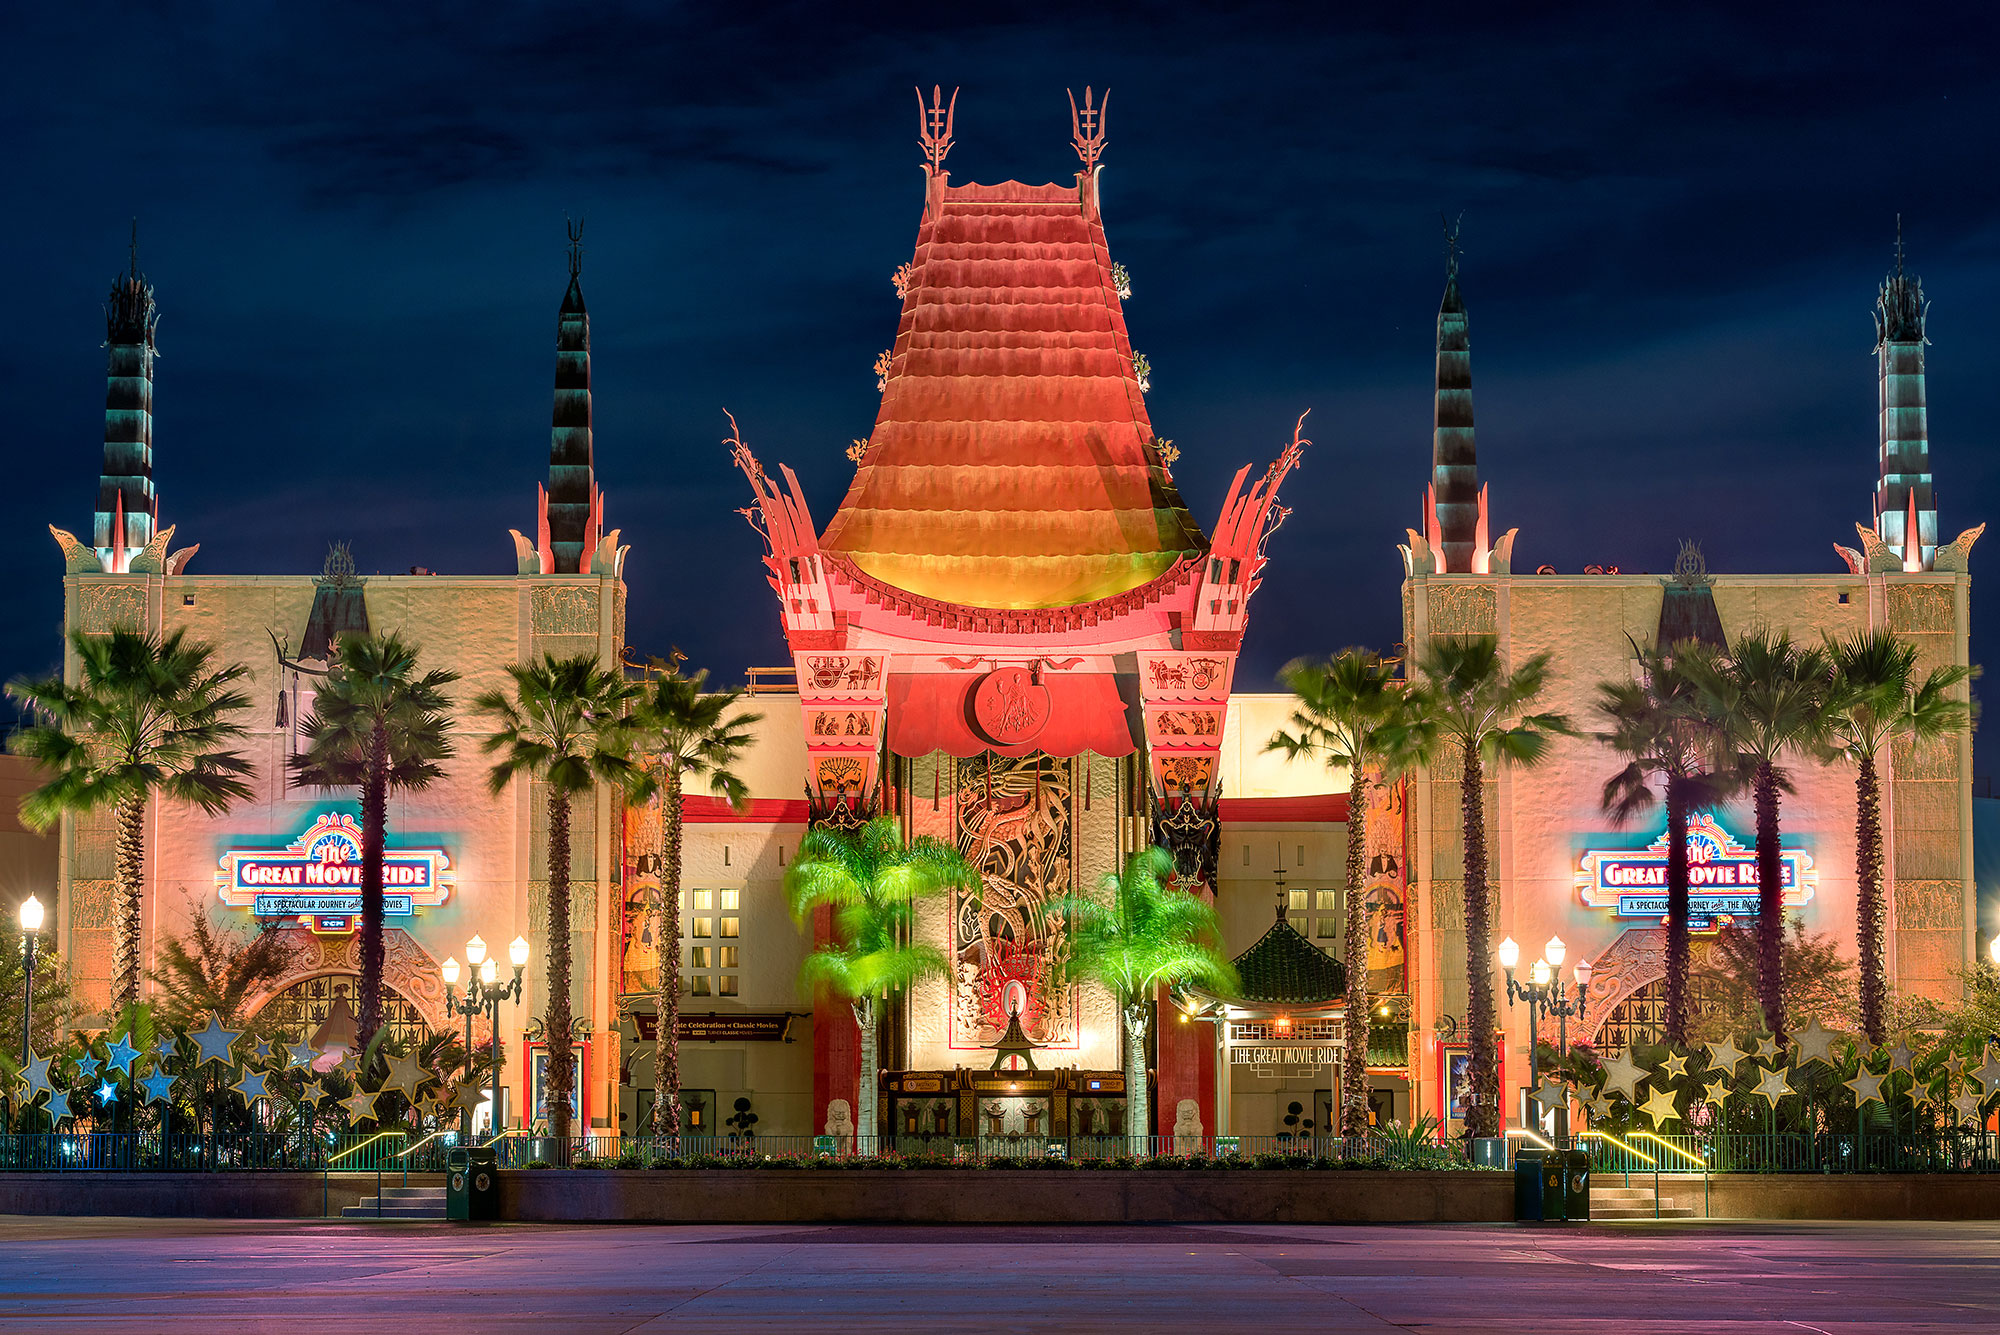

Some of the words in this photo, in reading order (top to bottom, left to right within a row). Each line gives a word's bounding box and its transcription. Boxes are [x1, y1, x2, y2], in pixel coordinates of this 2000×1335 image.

[315, 839, 350, 864] The
[241, 863, 302, 885] GREAT
[305, 863, 363, 885] MOVI
[1604, 863, 1667, 885] GREAT
[1688, 866, 1736, 885] OVIE
[1738, 863, 1792, 885] RE
[266, 900, 272, 909] A
[273, 900, 316, 909] SPECTACULAR
[317, 900, 347, 909] JOURNEY
[384, 900, 403, 909] OVIES
[1629, 900, 1635, 910] A
[1636, 900, 1668, 910] SPECTACU
[1688, 900, 1710, 910] URNEY
[1727, 901, 1740, 910] THE
[1741, 899, 1757, 910] MOV
[688, 1021, 726, 1029] Celebration
[733, 1021, 756, 1029] Classic
[756, 1021, 779, 1029] Movies
[1234, 1047, 1251, 1064] THE
[1253, 1047, 1282, 1064] GREAT
[1284, 1047, 1314, 1064] MOVIE
[1317, 1047, 1339, 1064] RIDE
